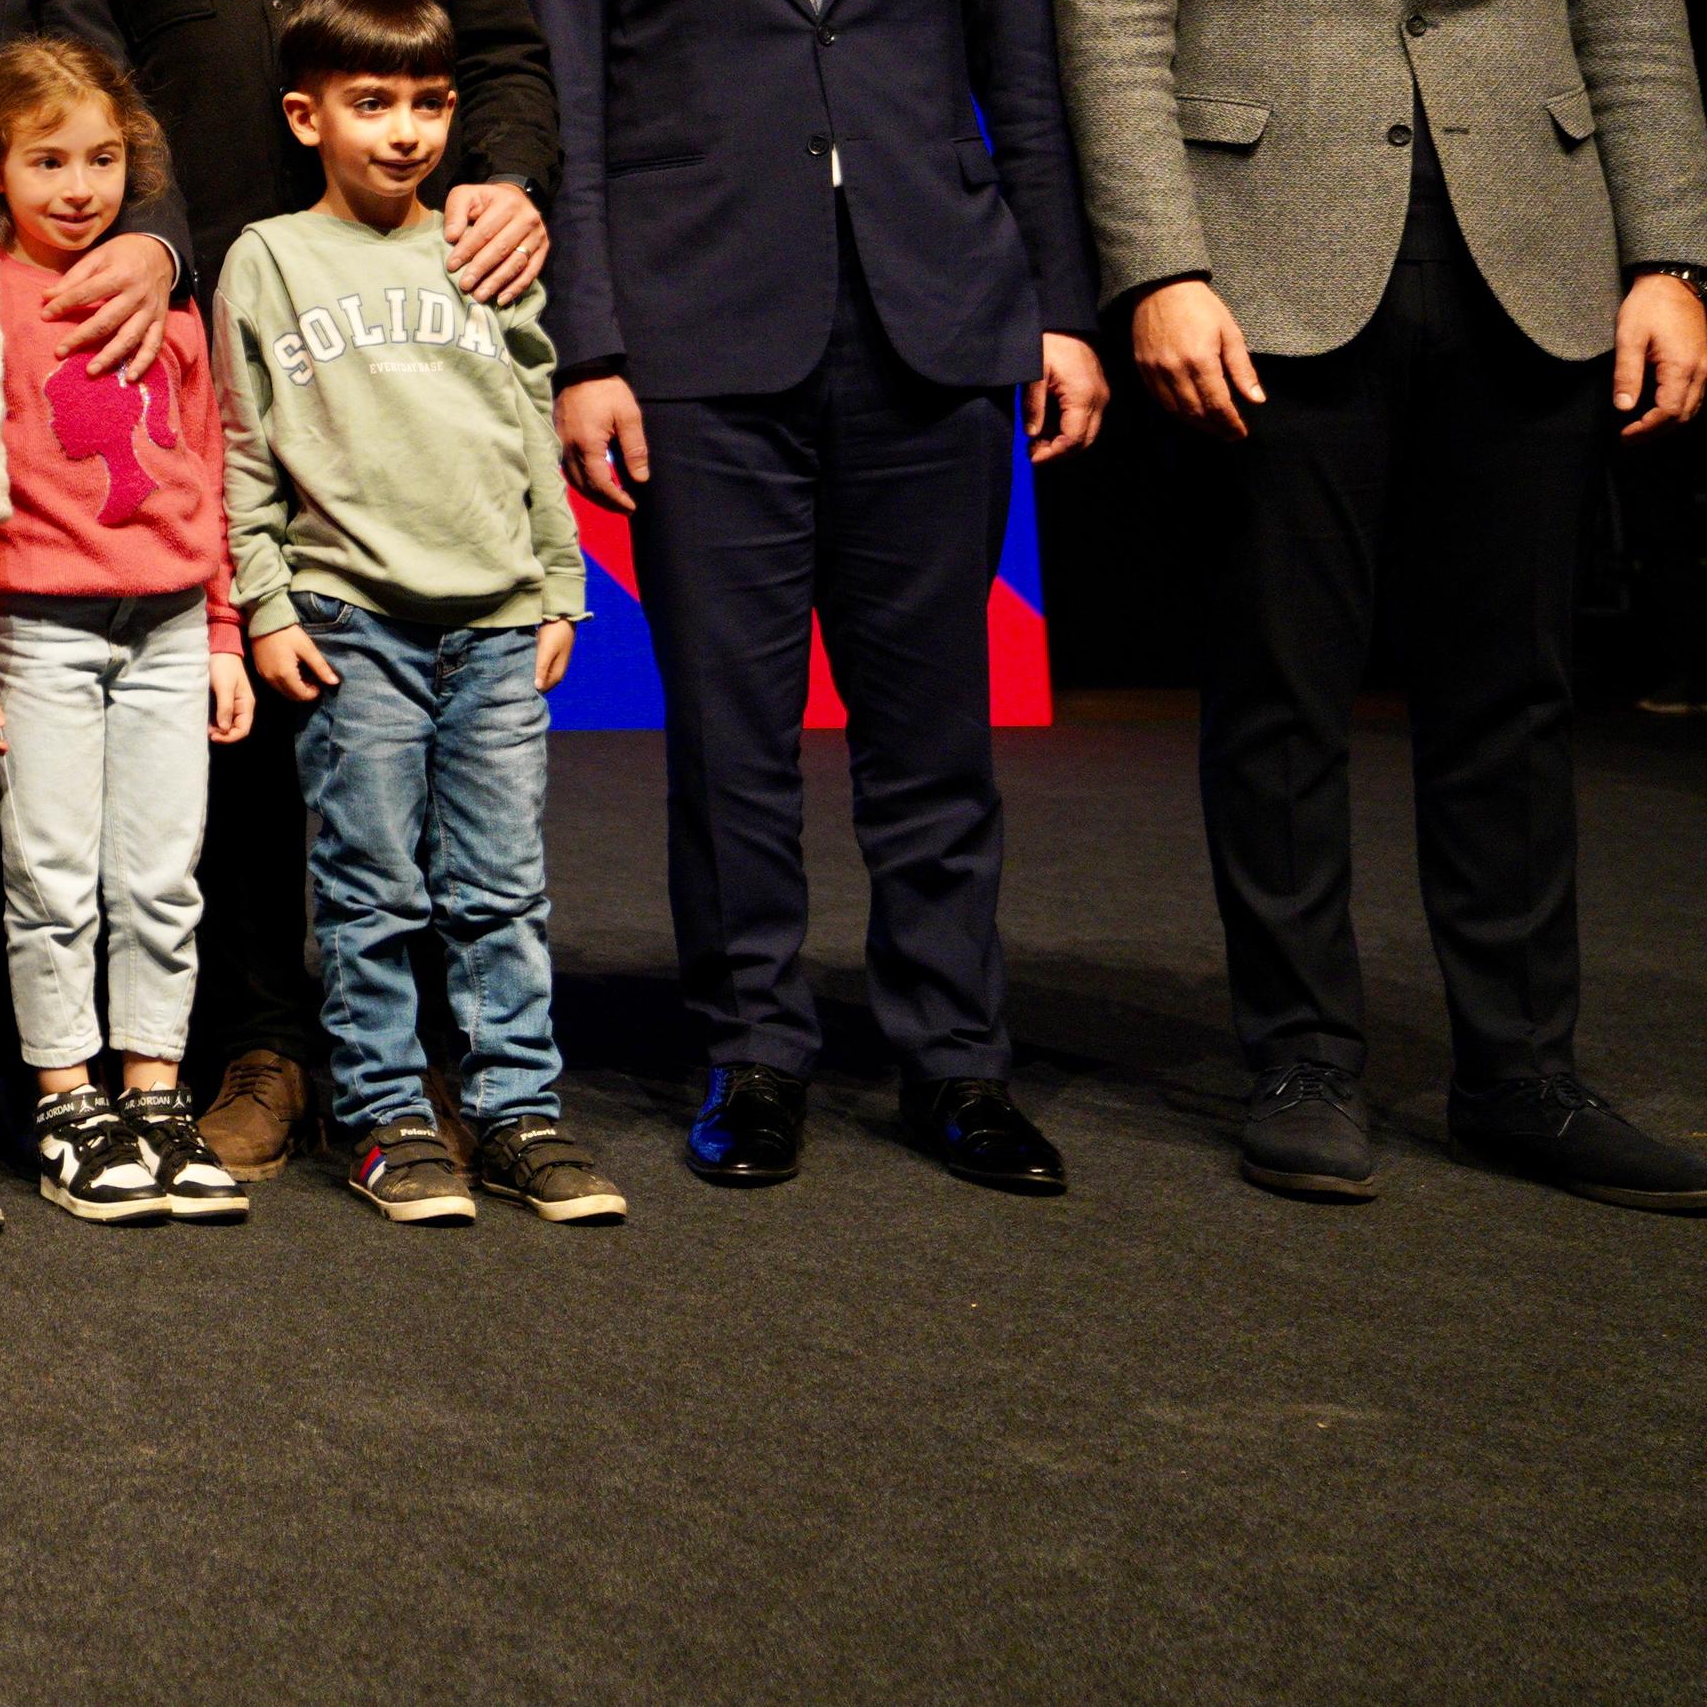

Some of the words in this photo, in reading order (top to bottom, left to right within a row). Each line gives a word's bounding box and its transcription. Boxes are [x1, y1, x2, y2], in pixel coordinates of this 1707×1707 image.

[272, 287, 511, 387] SOLIDA
[138, 1095, 171, 1107] JORDAN
[45, 1102, 74, 1120] JORDAN
